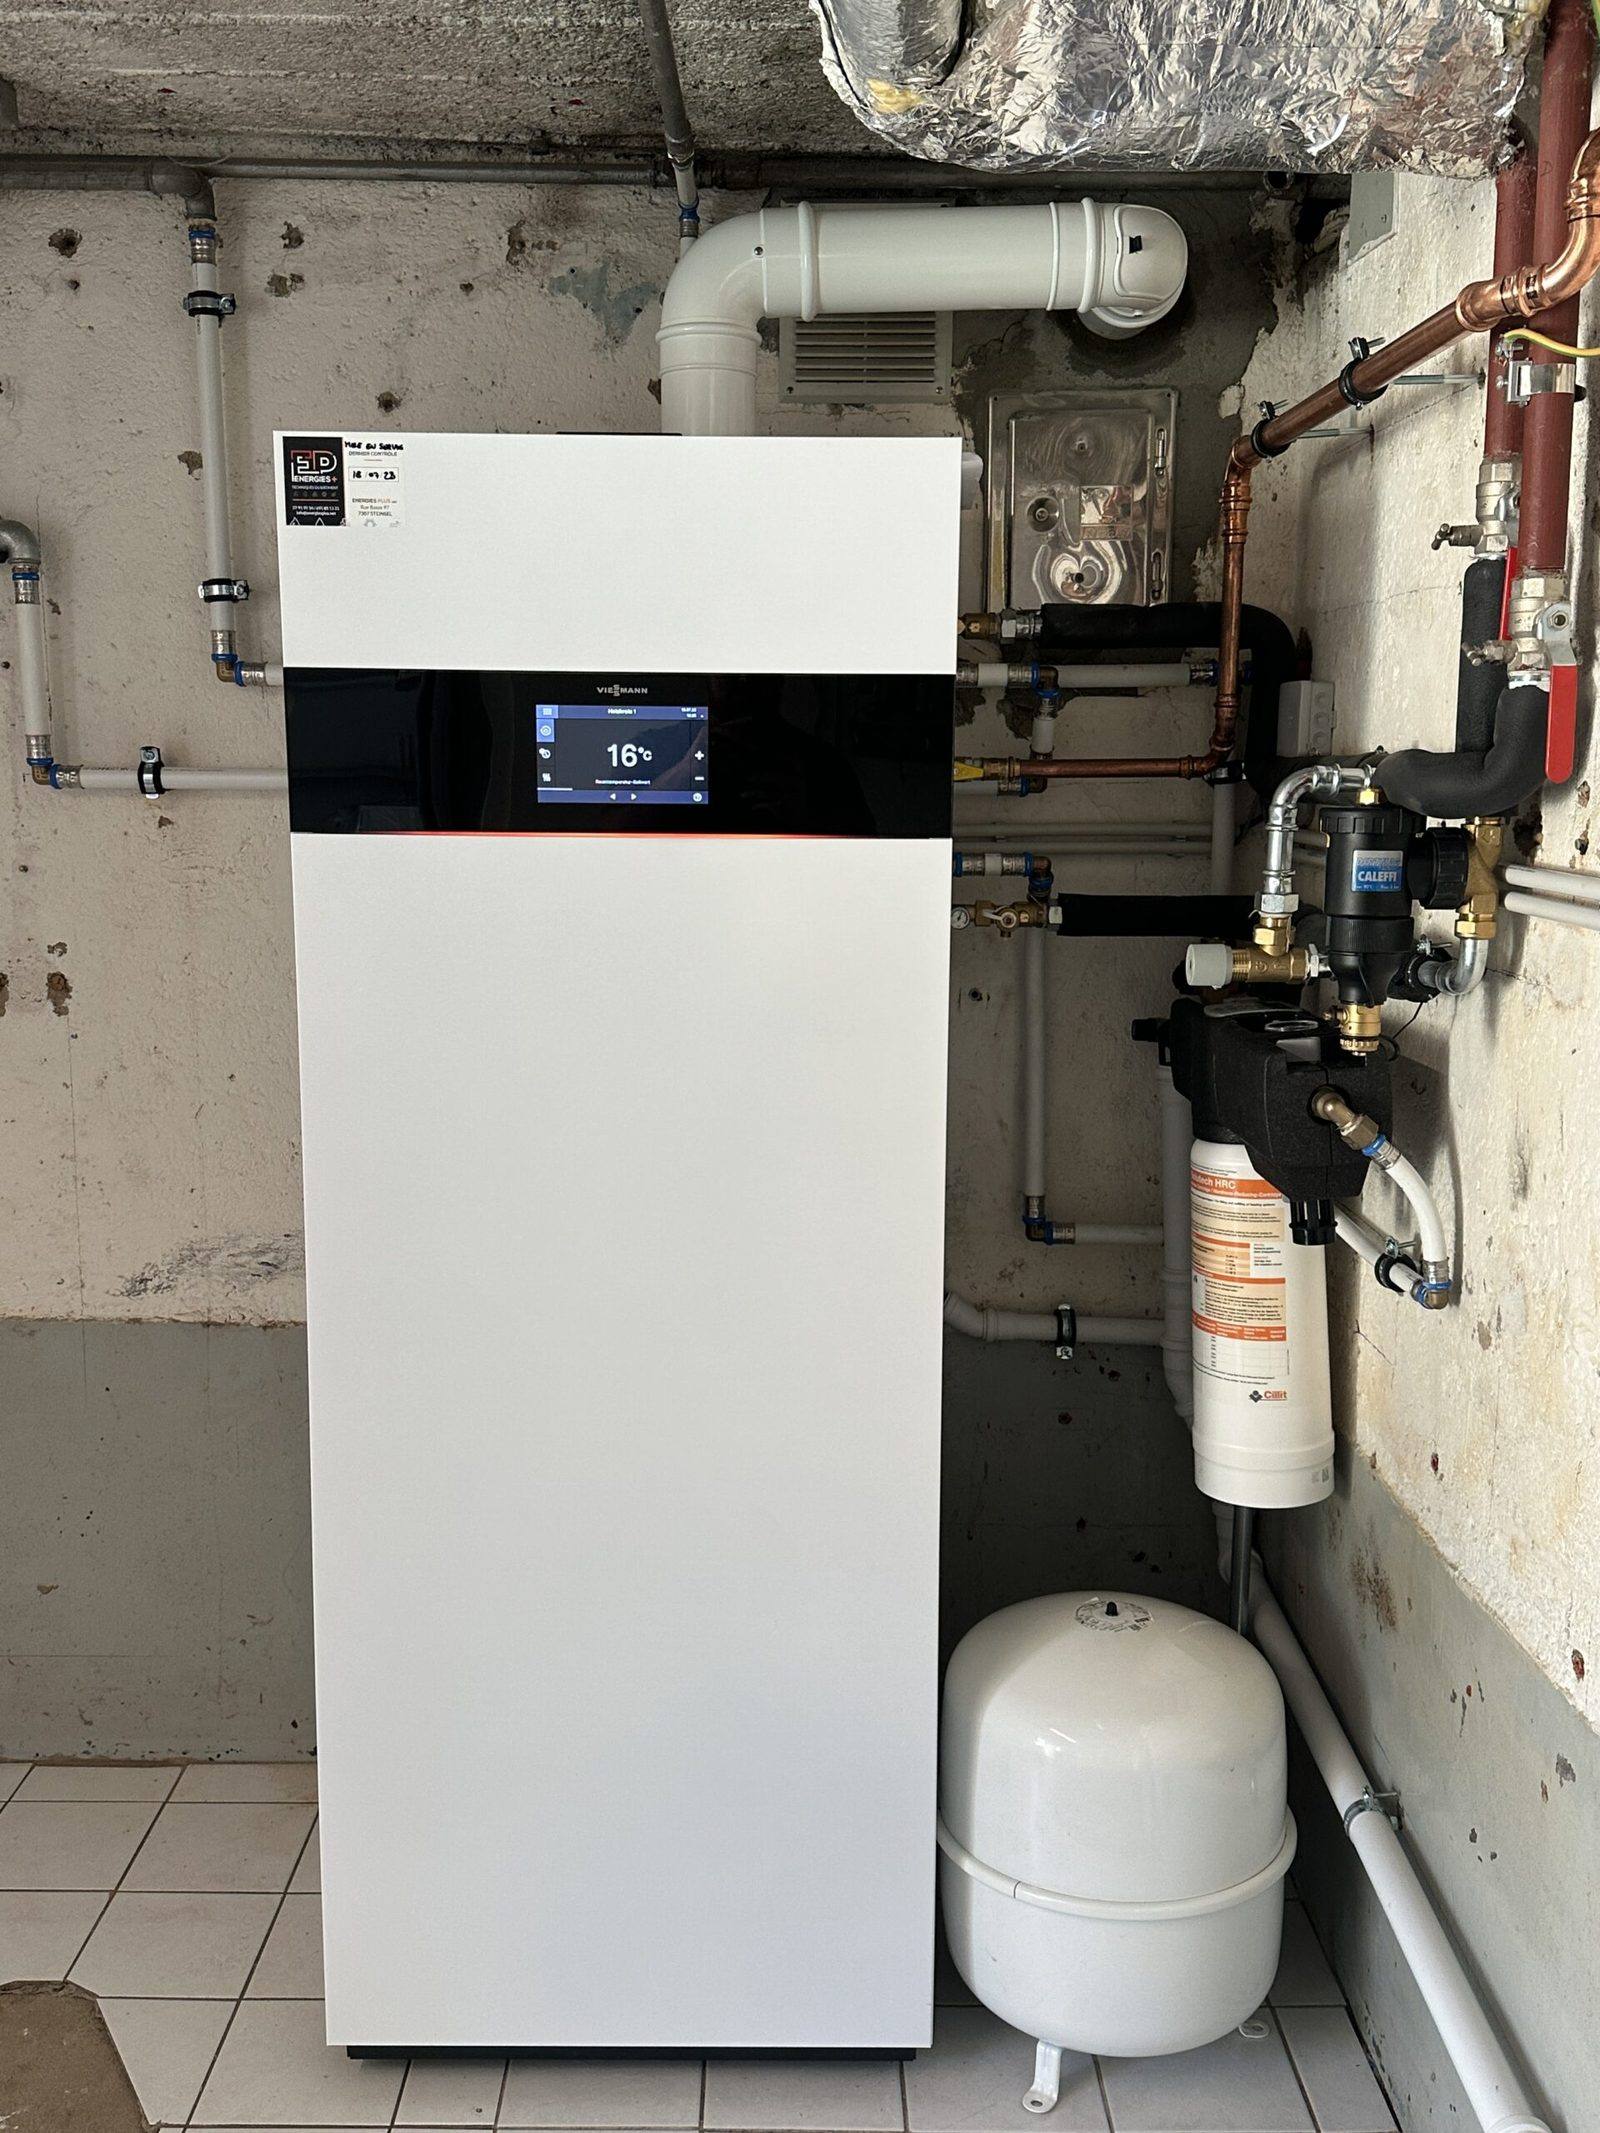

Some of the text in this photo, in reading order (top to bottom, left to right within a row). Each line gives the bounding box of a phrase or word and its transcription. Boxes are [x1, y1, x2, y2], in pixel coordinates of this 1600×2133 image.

[596, 684, 648, 697] VIESSMANN
[1358, 871, 1397, 881] CALEFFI
[1214, 1178, 1237, 1190] HRC
